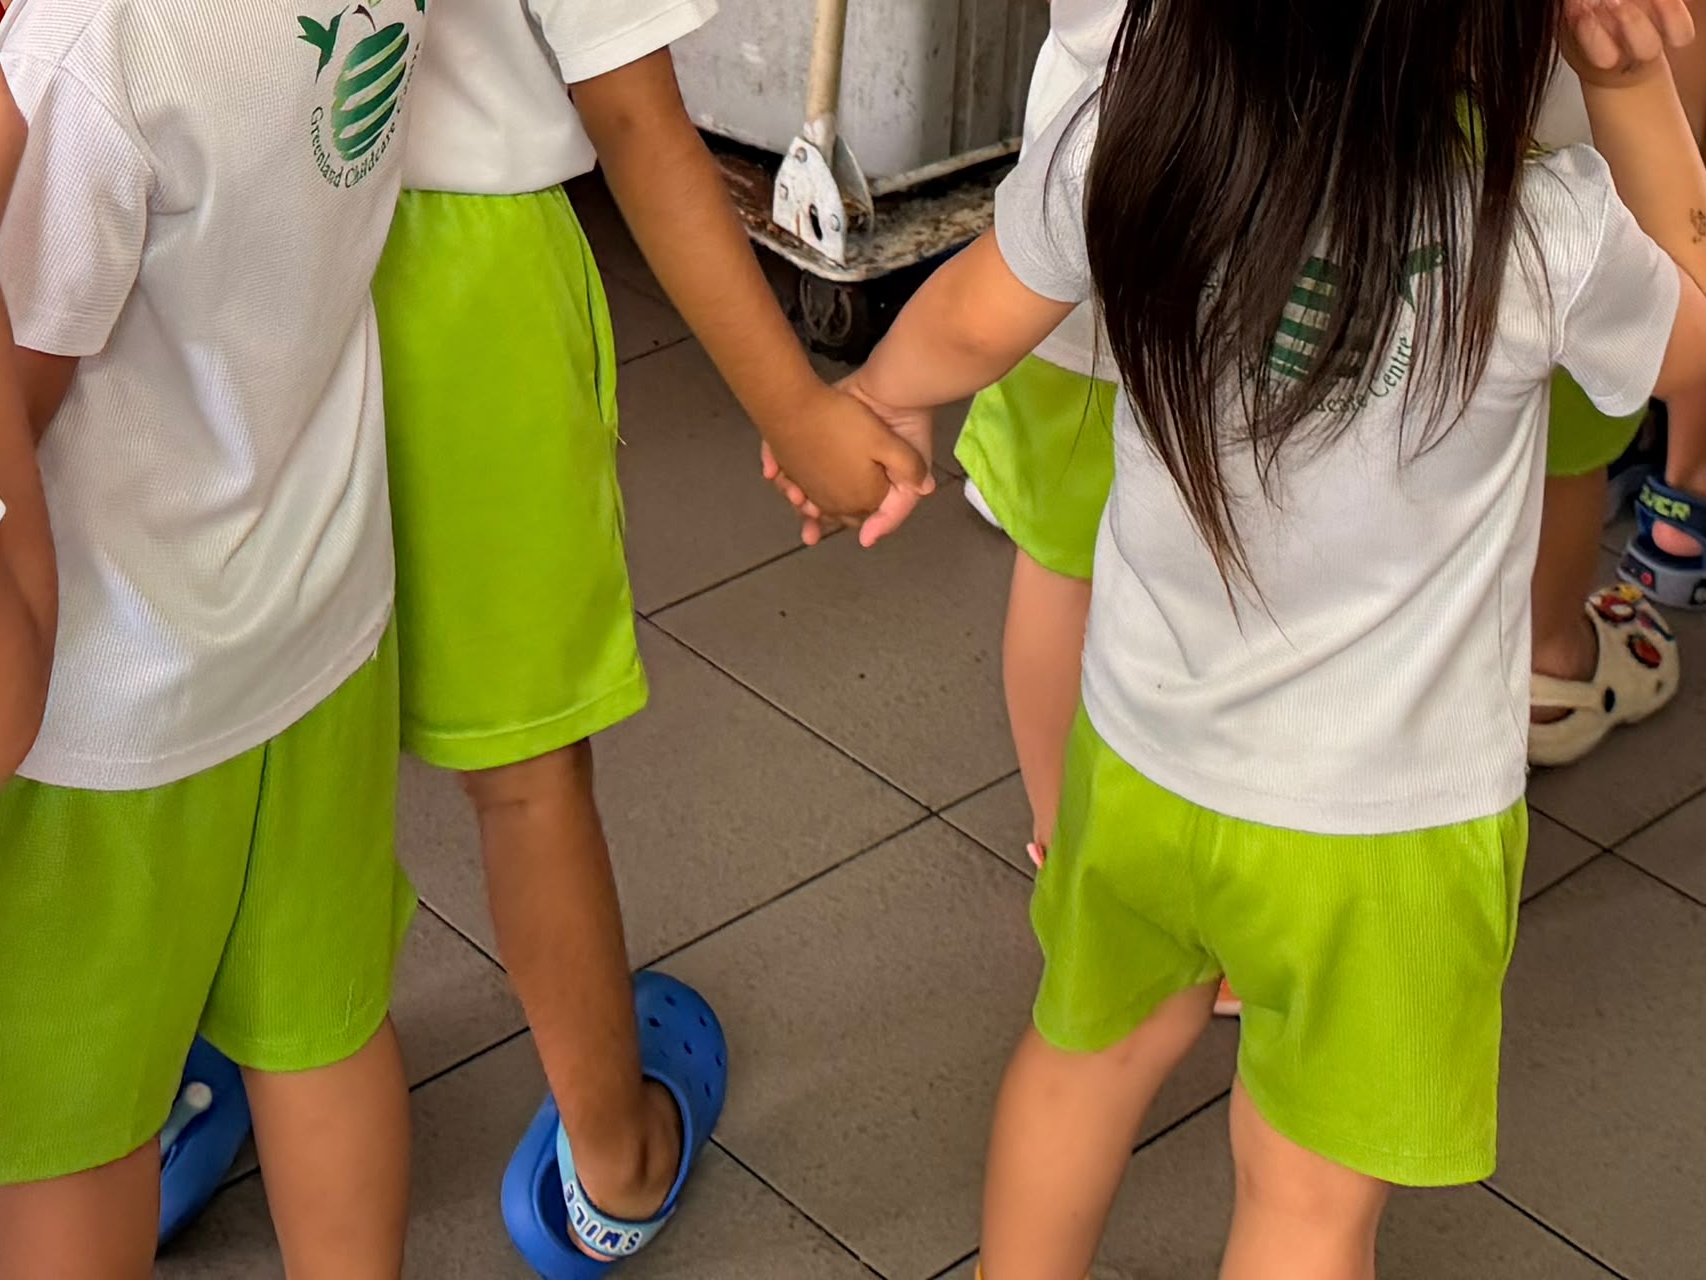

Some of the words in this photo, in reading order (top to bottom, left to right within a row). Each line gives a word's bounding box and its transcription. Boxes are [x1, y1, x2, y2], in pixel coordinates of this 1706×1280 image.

[310, 106, 344, 189] Greenland
[344, 121, 396, 189] Childcare
[1368, 336, 1413, 398] Centre
[563, 1180, 643, 1254] SMILE
